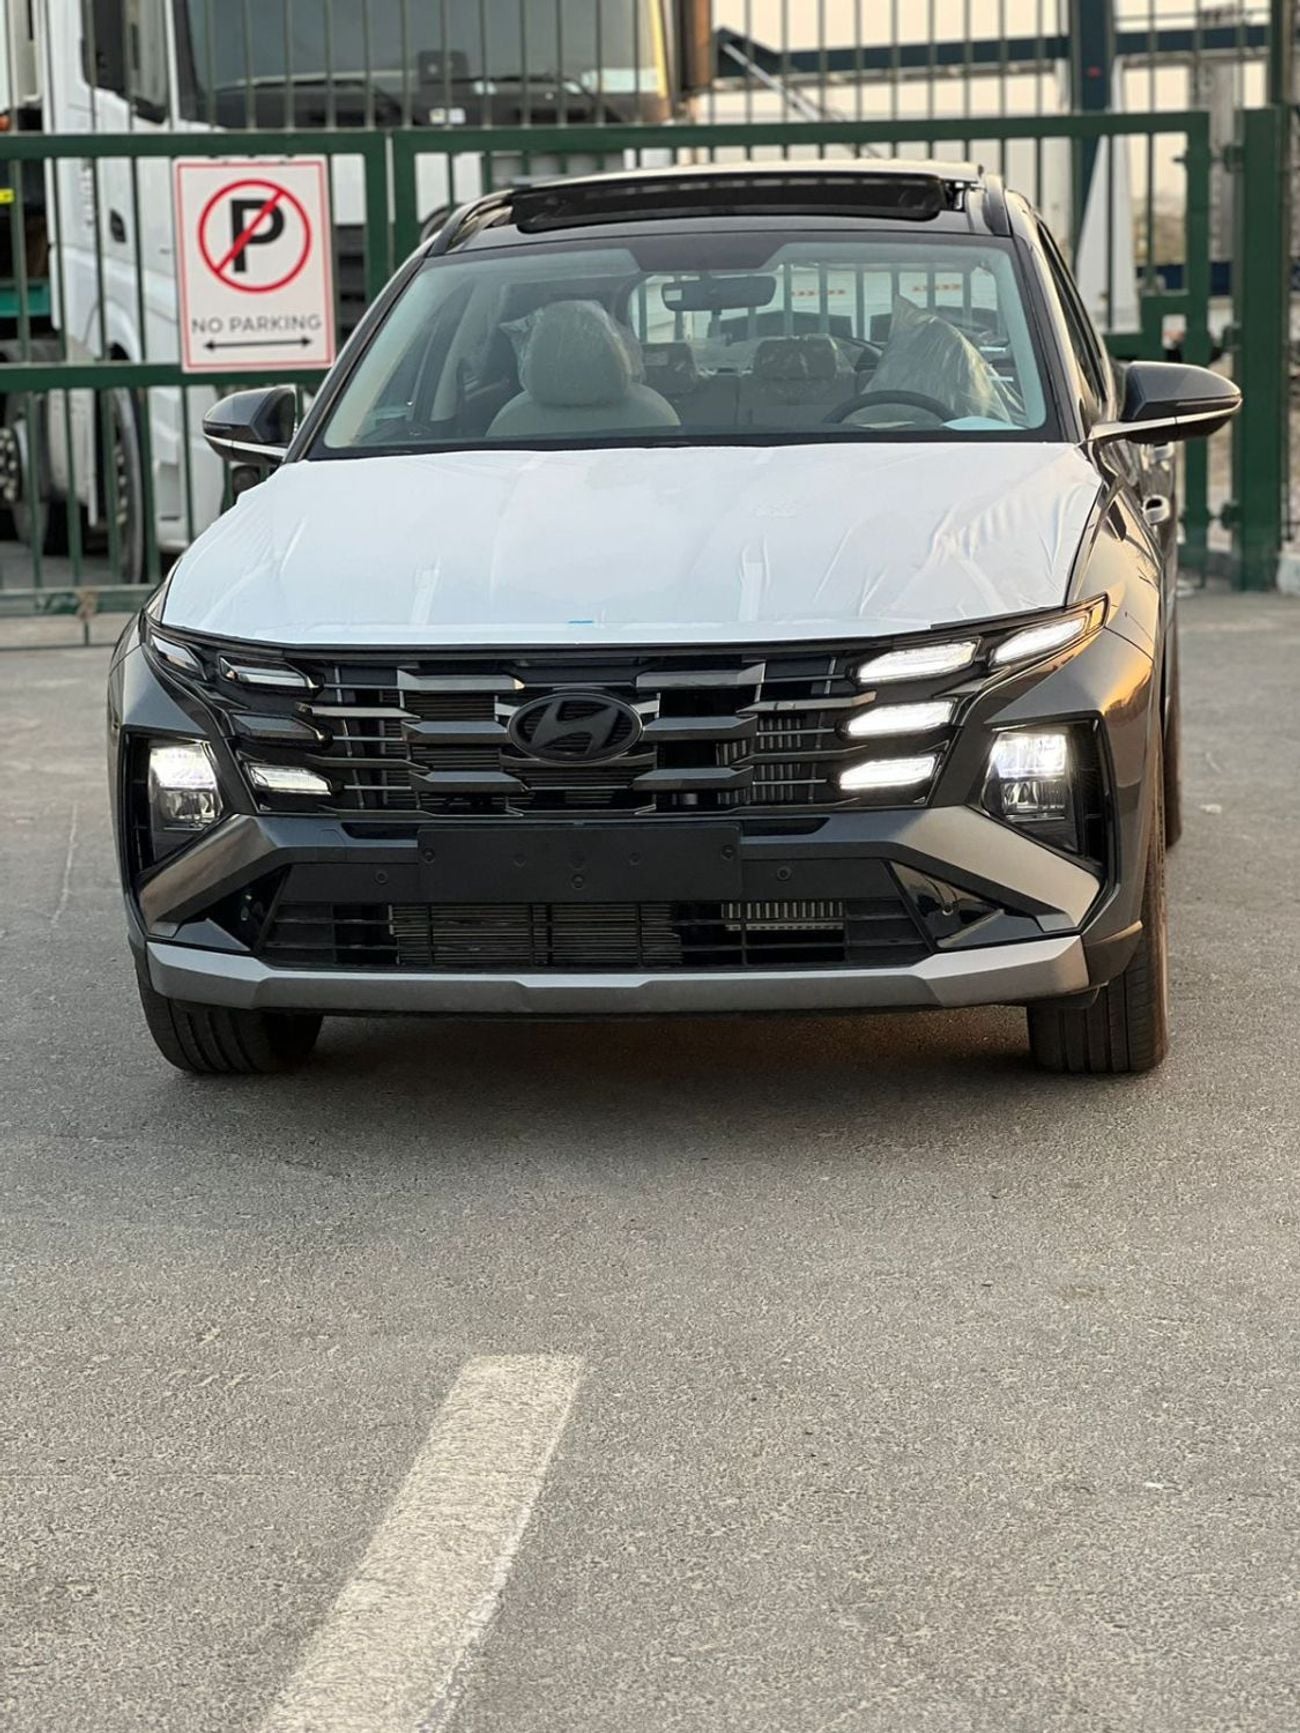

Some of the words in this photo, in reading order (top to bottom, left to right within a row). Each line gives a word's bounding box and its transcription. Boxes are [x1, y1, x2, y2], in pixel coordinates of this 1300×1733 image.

[230, 199, 285, 273] P
[192, 317, 223, 334] NO
[229, 314, 322, 332] PARKING
